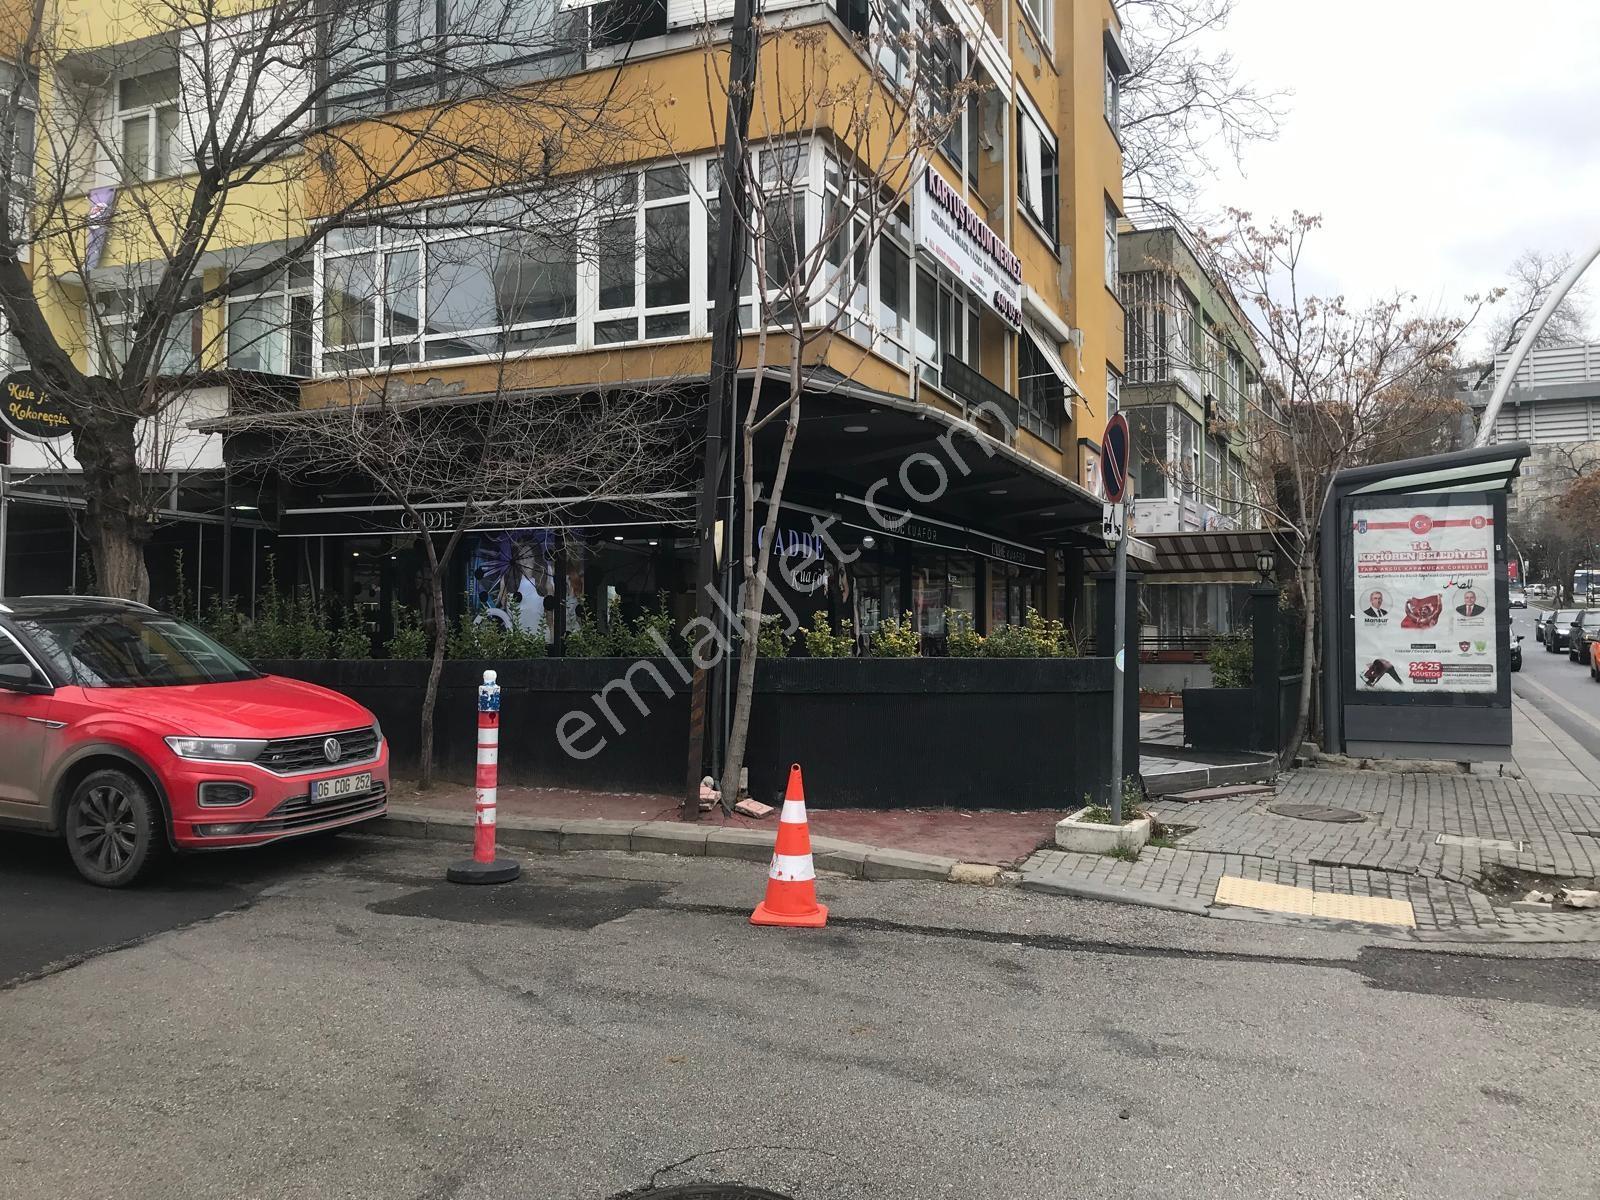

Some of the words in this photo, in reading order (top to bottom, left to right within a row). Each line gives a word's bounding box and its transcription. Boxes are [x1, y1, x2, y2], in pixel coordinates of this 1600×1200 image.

[925, 166, 966, 230] KARTUŞ
[965, 206, 994, 254] DOLUM
[8, 382, 35, 400] Kule
[758, 525, 825, 560] CADDE
[1359, 550, 1416, 564] KEÇİÖREN
[1417, 548, 1487, 561] BELEDİYESİ
[1411, 663, 1440, 671] 24-25
[318, 782, 329, 797] 06
[355, 775, 370, 790] 252
